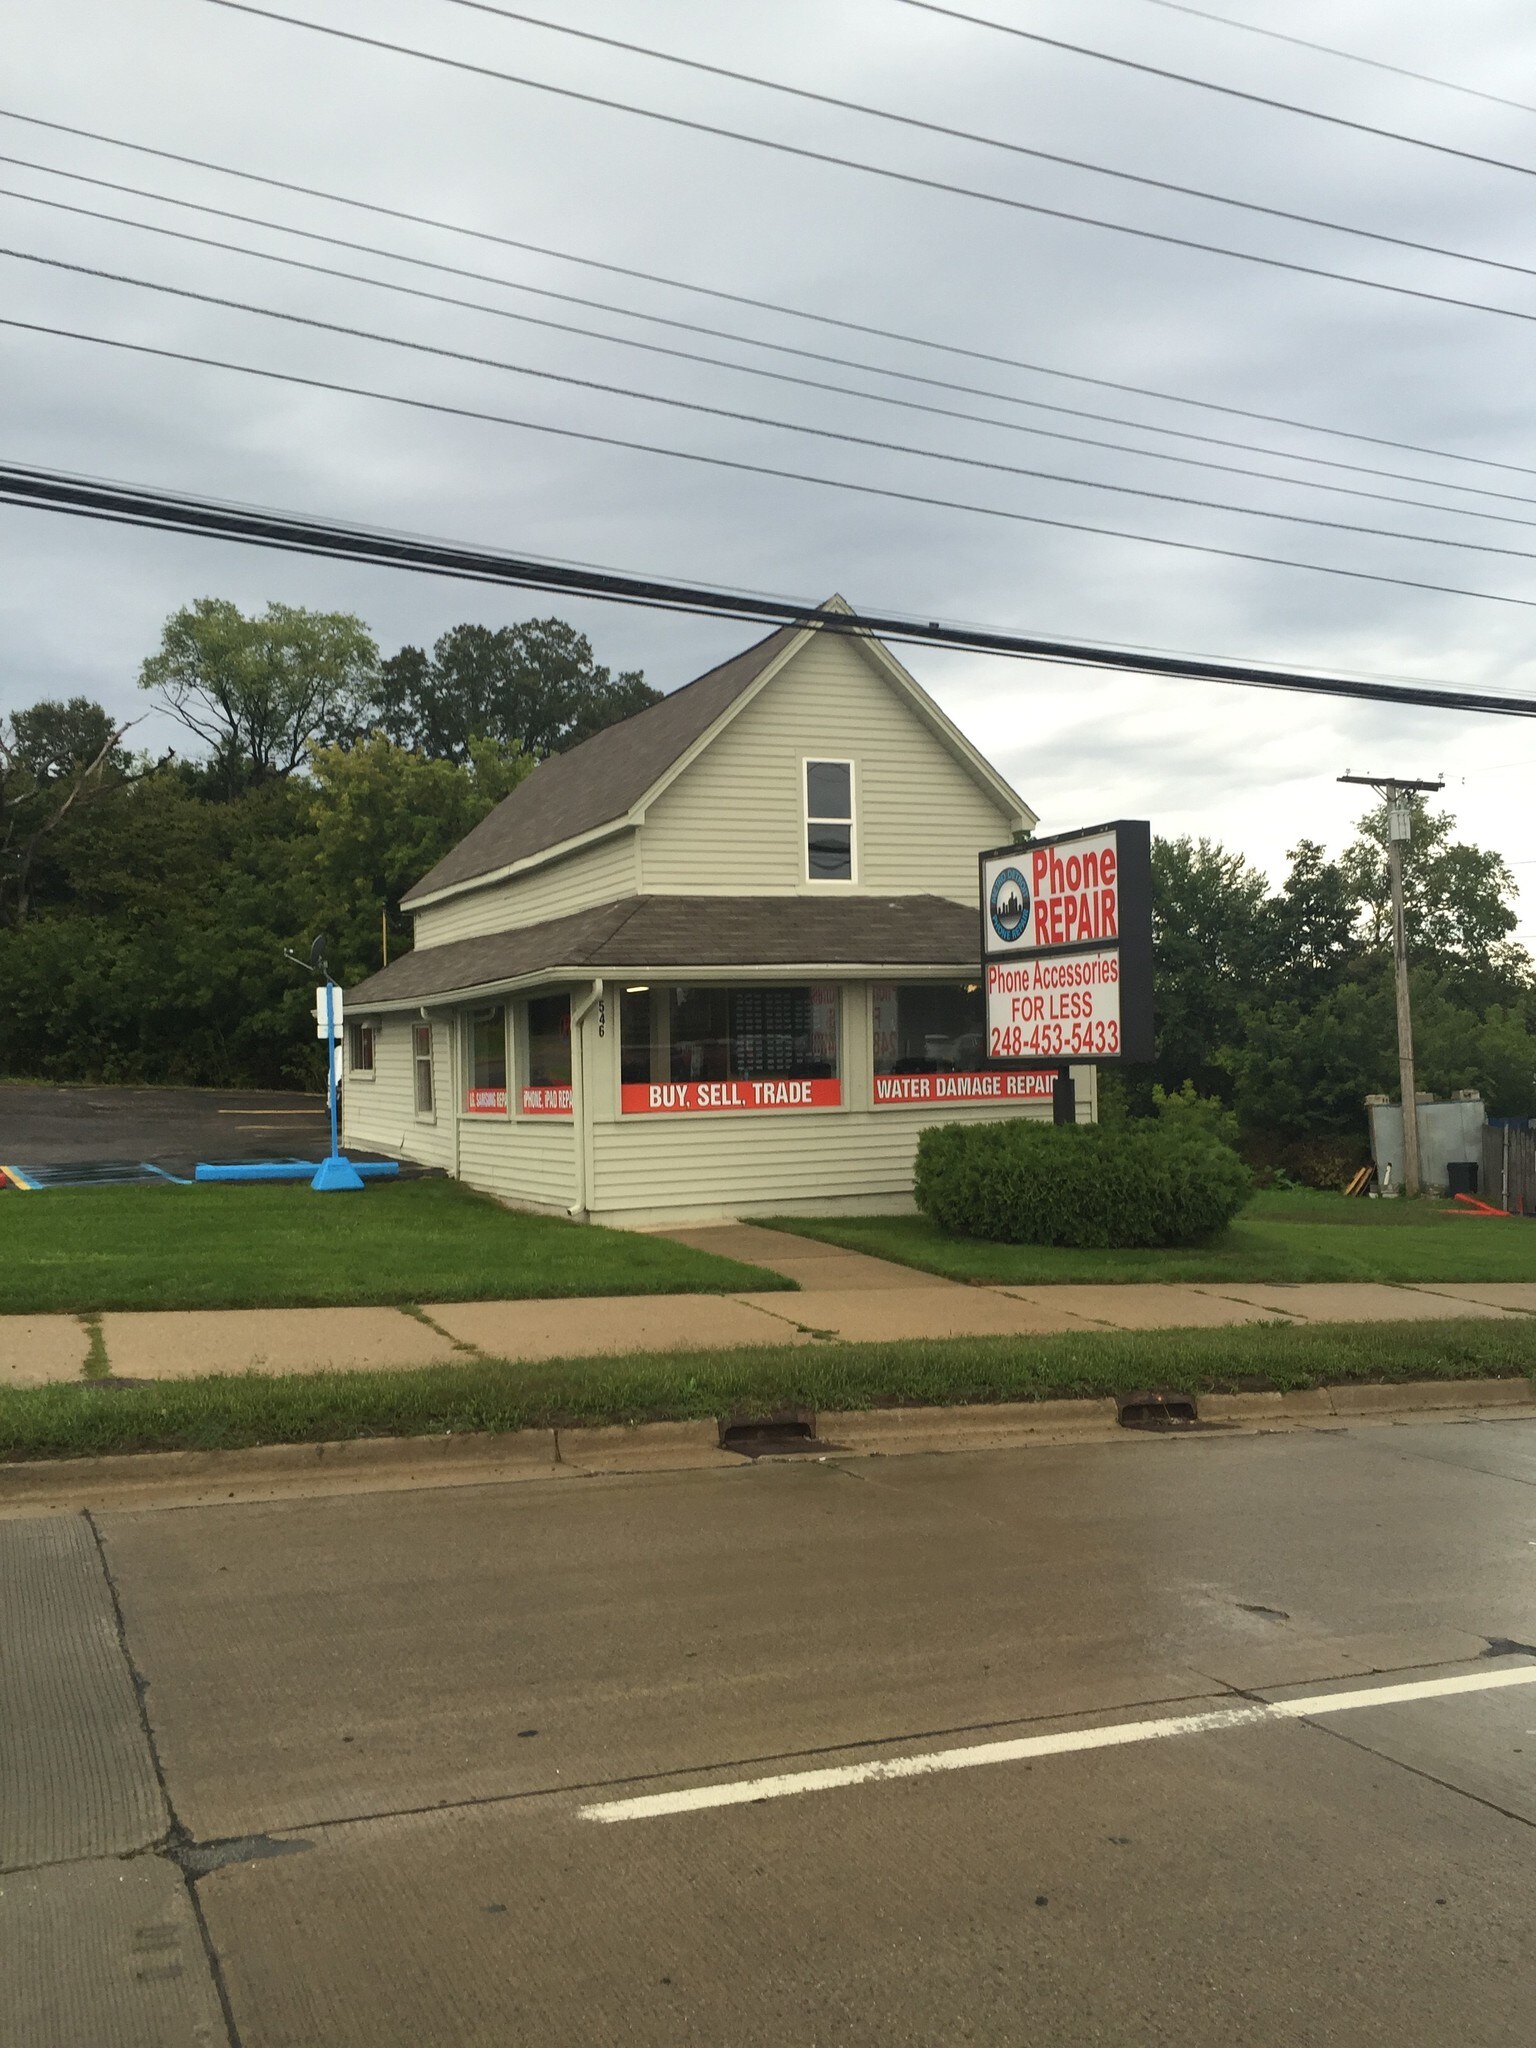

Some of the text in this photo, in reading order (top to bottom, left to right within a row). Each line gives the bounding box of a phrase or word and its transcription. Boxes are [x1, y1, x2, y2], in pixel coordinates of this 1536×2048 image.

[1032, 847, 1117, 897] Phone
[1033, 888, 1117, 945] REPAIR
[988, 953, 1118, 994] Phone Accessories
[597, 1000, 605, 1038] 546
[1012, 991, 1093, 1022] FOR LESS
[991, 1020, 1119, 1057] 248-453-5433
[649, 1081, 812, 1109] BUY, SELL, TRADE
[876, 1077, 931, 1099] WATER
[936, 1075, 1002, 1097] DAMAGE
